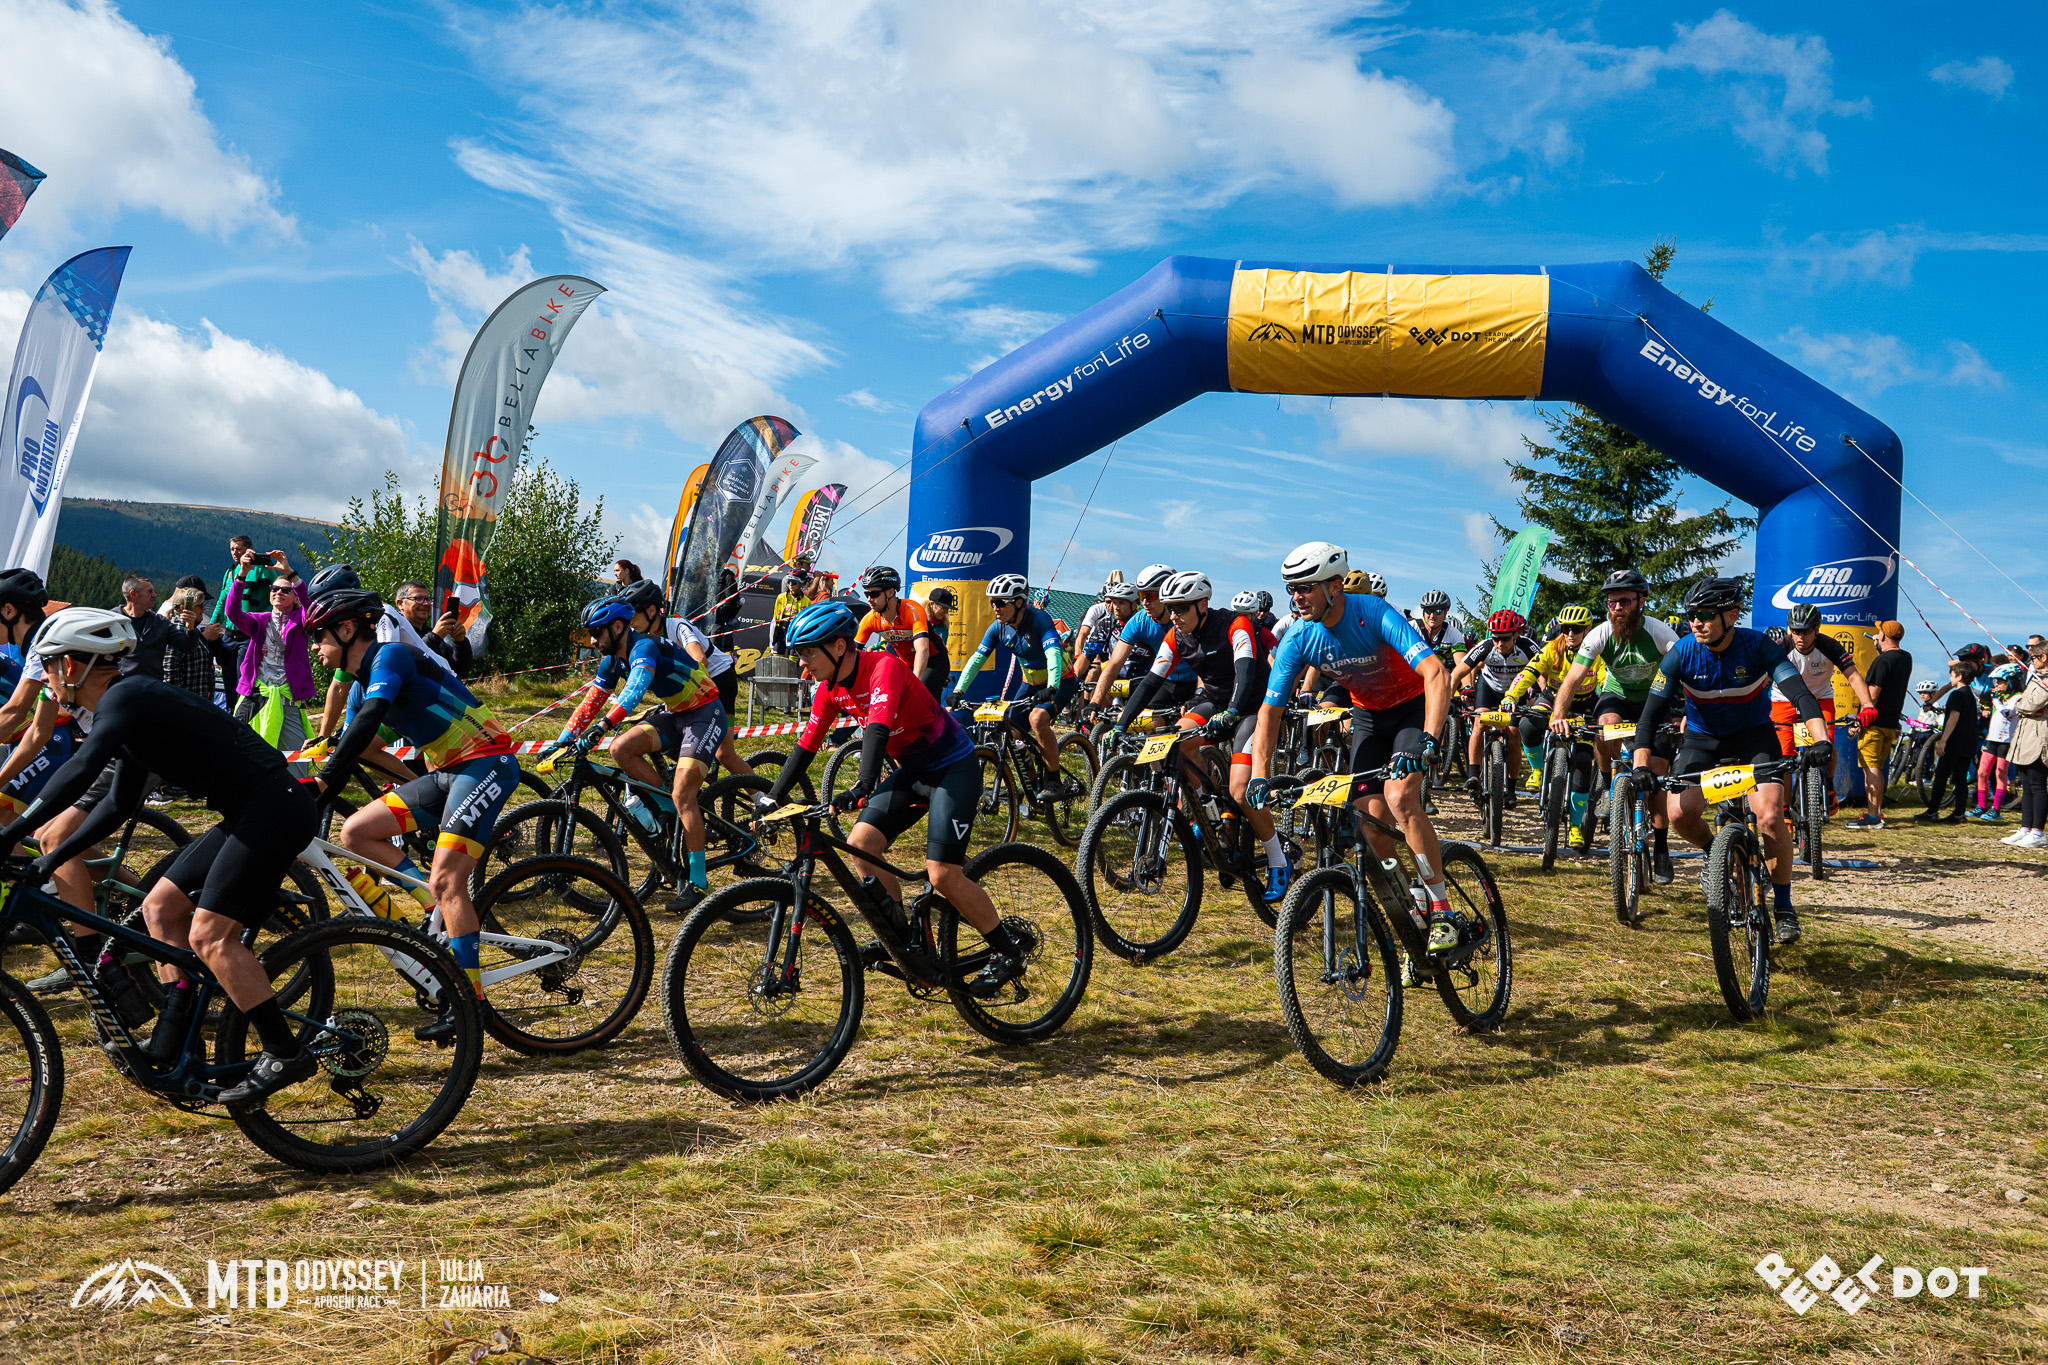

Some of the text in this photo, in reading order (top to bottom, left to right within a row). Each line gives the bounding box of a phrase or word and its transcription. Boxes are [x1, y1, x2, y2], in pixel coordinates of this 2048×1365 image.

[1302, 324, 1382, 345] MTB ODYSSEY
[1451, 331, 1482, 342] DOT
[20, 436, 41, 484] PRO
[35, 419, 59, 497] NUTRITION
[919, 549, 984, 565] NUTRITION
[928, 535, 965, 551] PRO
[1516, 543, 1537, 598] CULTURE
[1805, 567, 1853, 584] PRO
[1792, 584, 1871, 598] NUTRITION
[1470, 645, 1485, 661] BMC
[696, 717, 716, 754] TRANSILVANIA
[705, 725, 722, 754] MTB
[9, 755, 51, 791] MTB
[446, 769, 498, 829] TRANSILVANIA
[460, 782, 502, 829] MTB
[277, 906, 305, 930] AXXI
[807, 899, 838, 926] AXXIS
[356, 927, 438, 960] vittoria BARZO
[33, 1032, 49, 1086] BARZO
